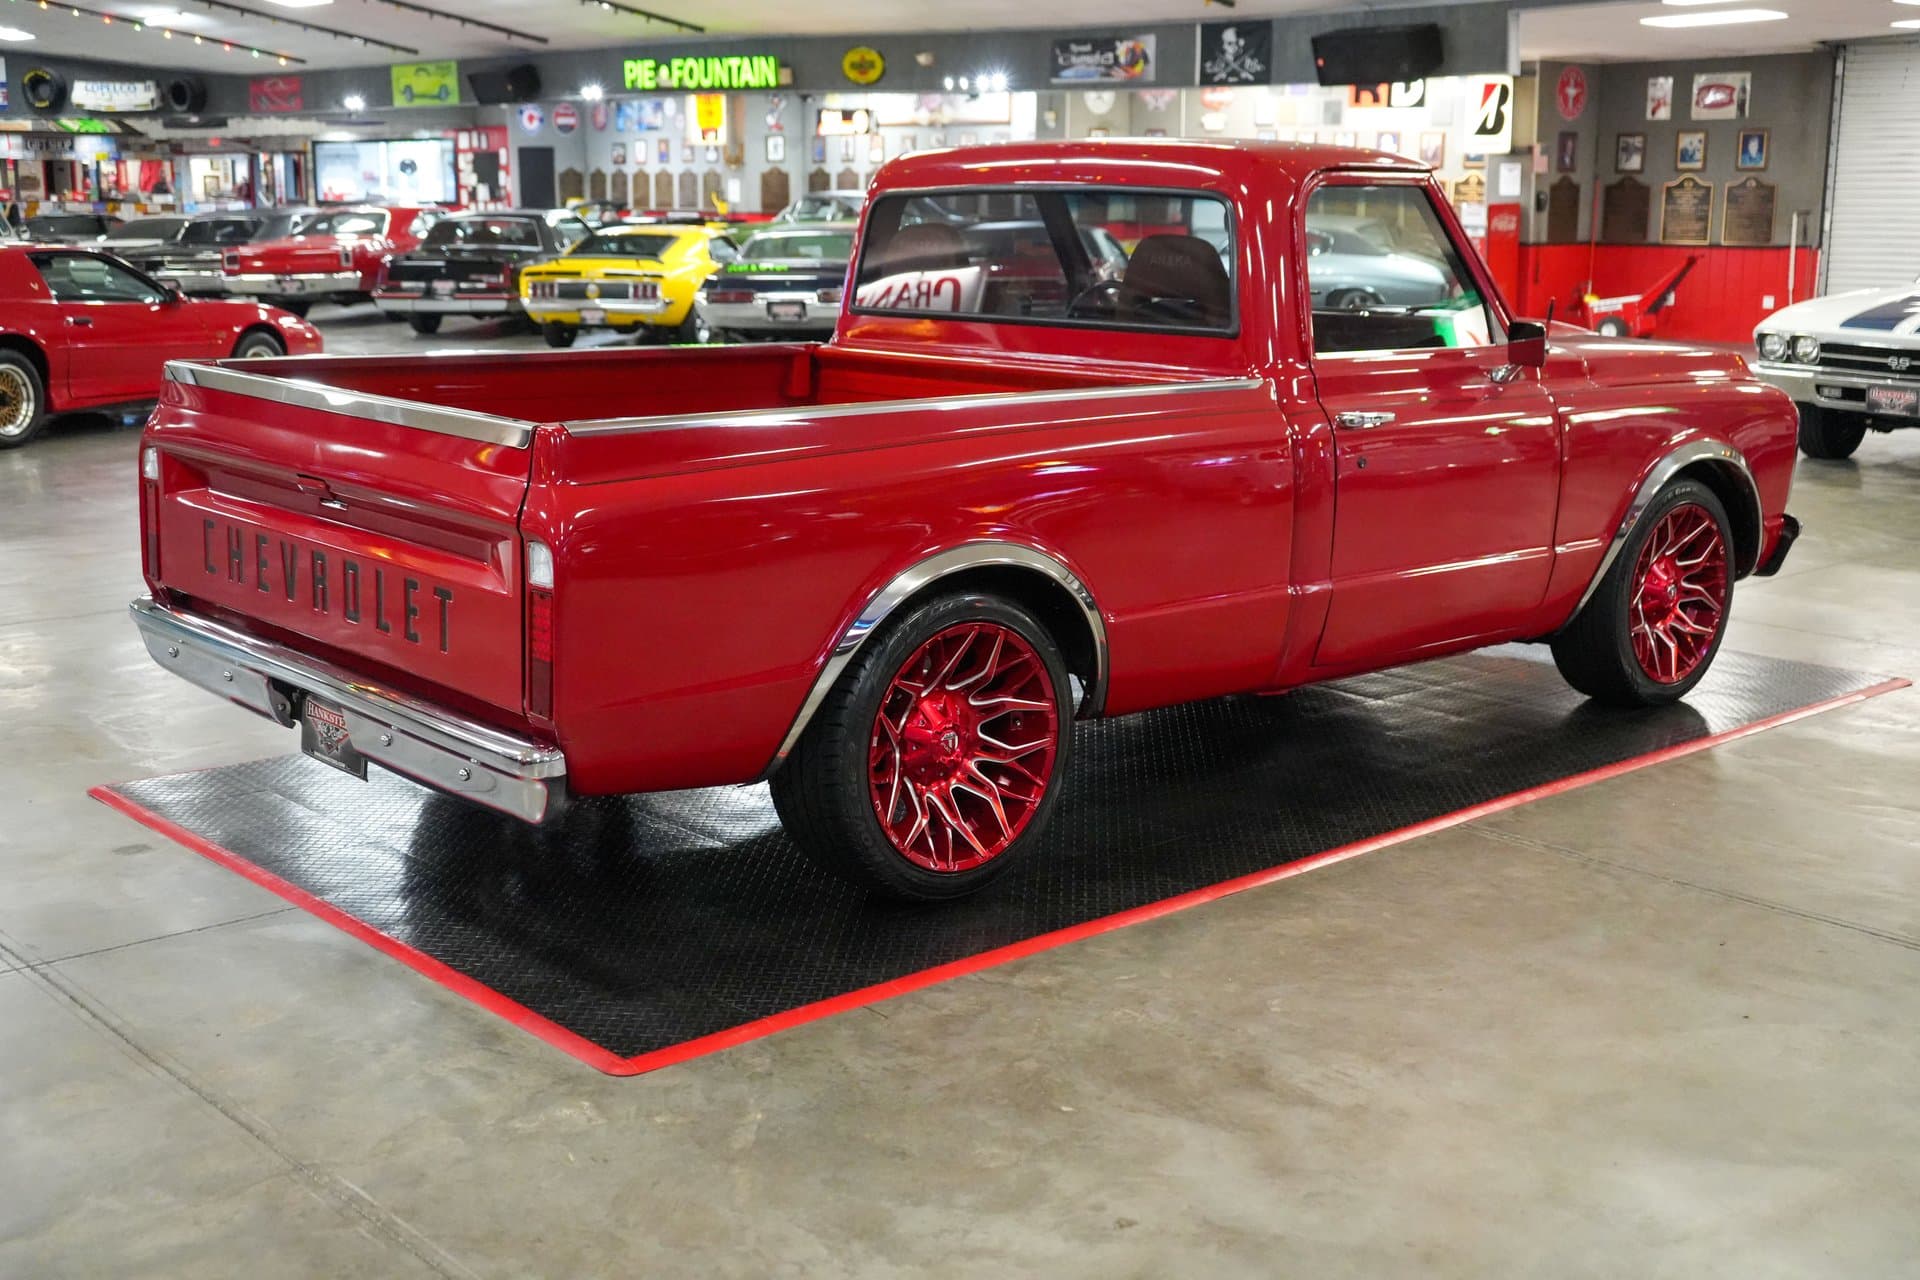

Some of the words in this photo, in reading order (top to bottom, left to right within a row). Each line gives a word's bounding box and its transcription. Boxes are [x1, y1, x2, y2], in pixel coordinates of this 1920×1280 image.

[623, 59, 656, 89] PIE
[670, 55, 776, 88] FOUNTAIN
[203, 518, 454, 655] CHEVROLET
